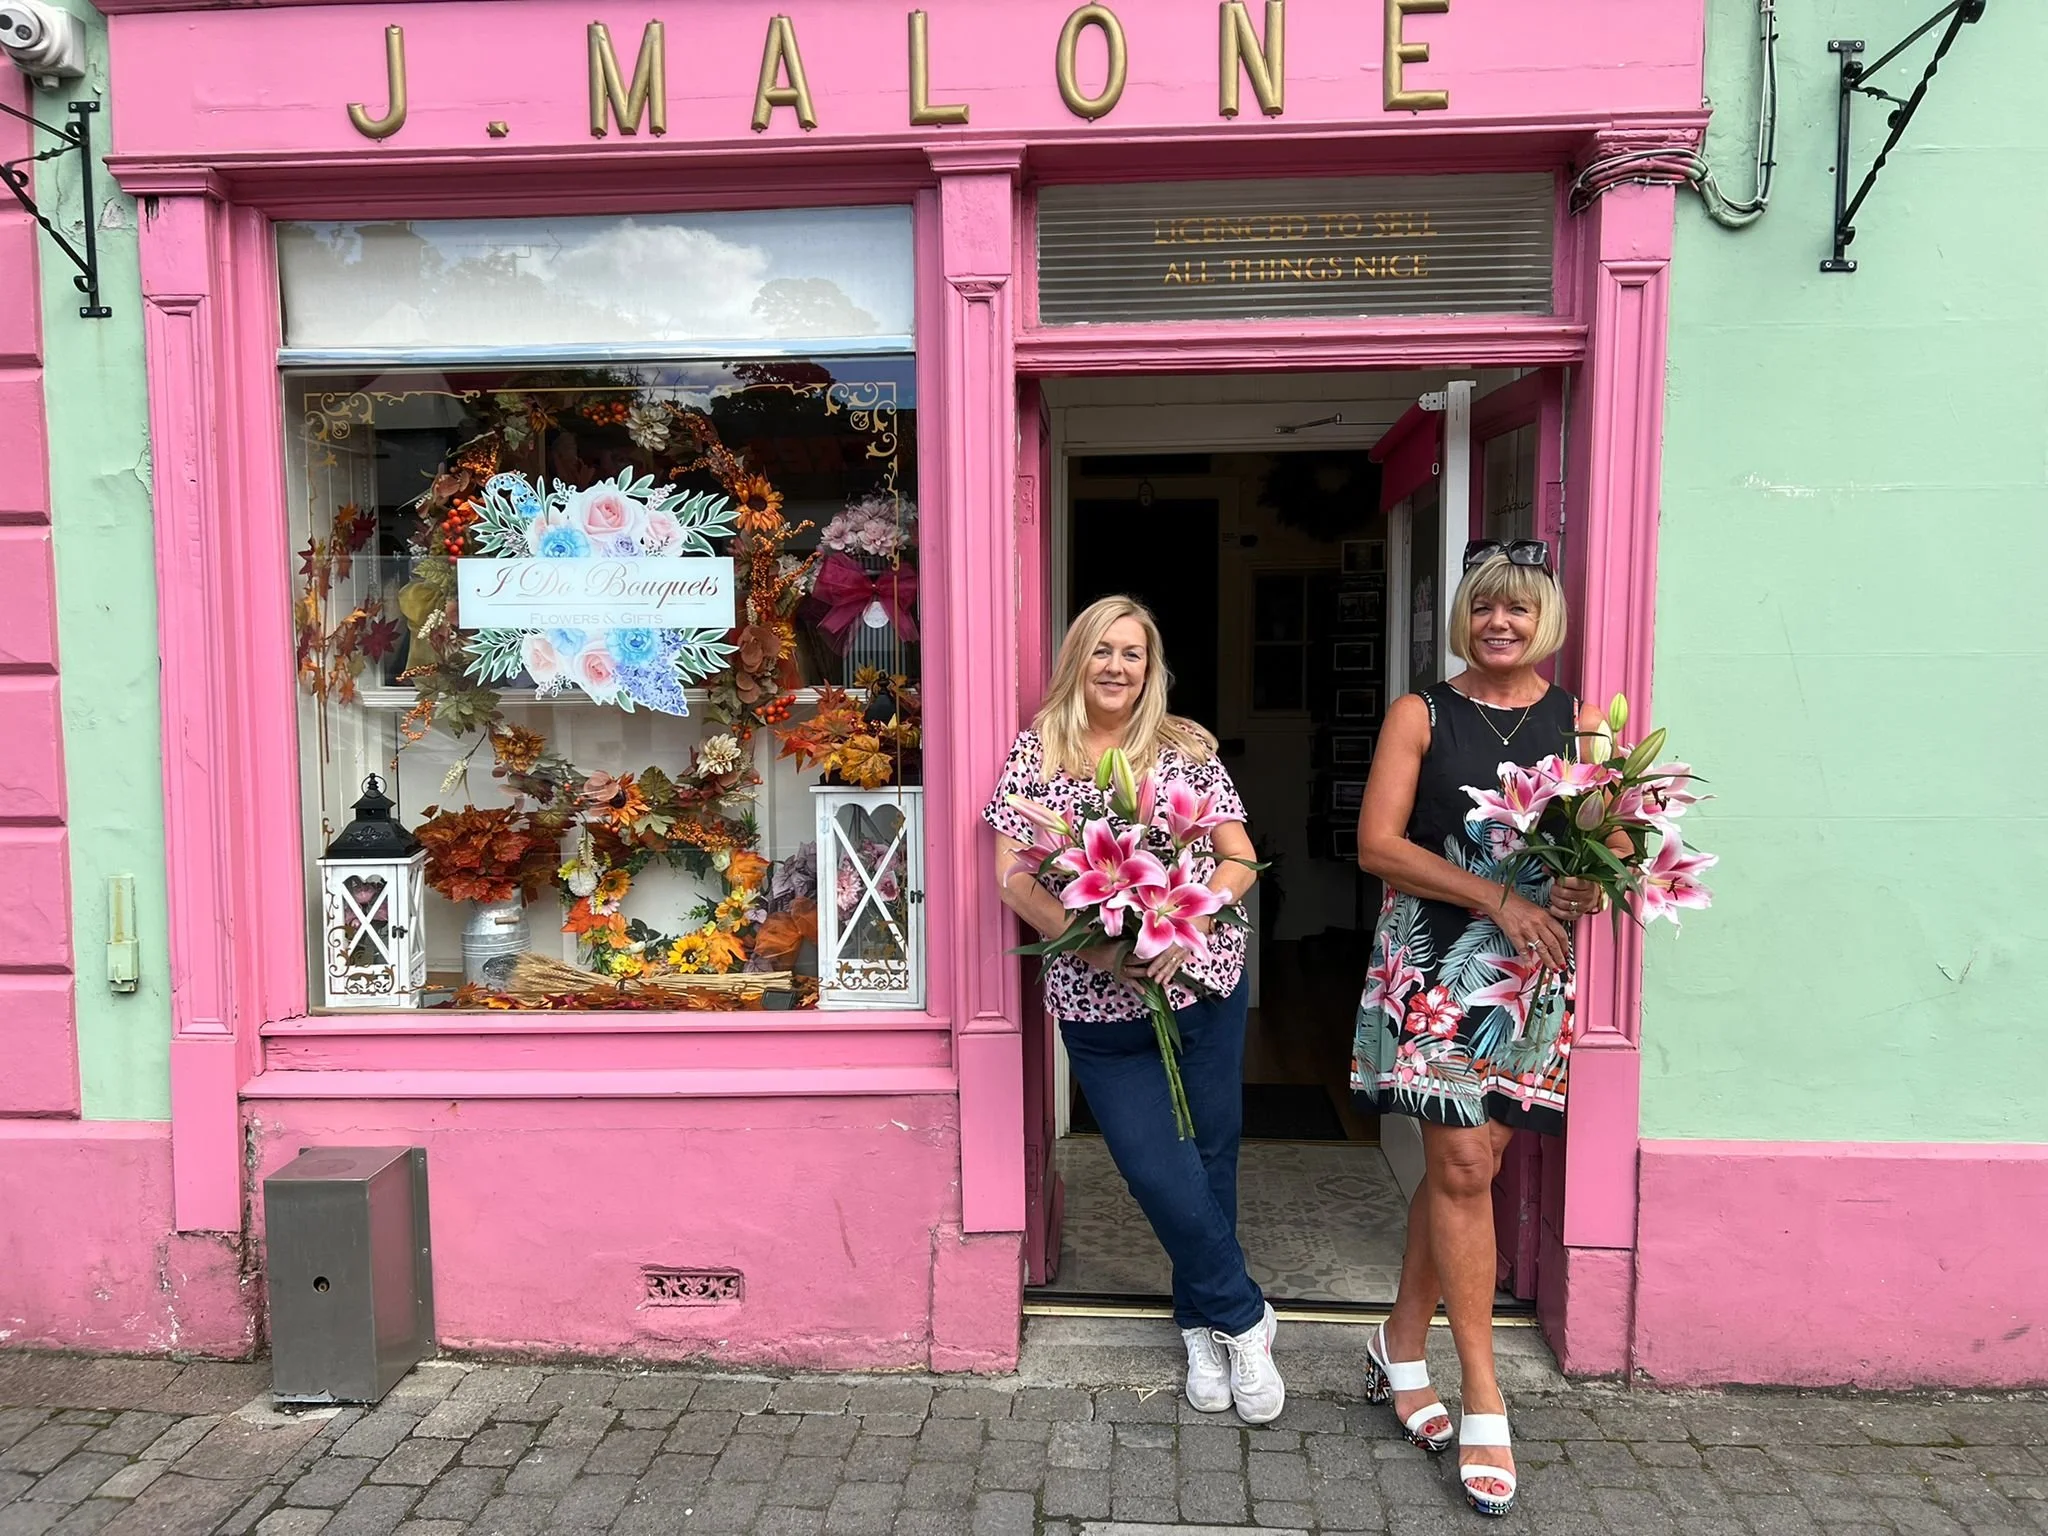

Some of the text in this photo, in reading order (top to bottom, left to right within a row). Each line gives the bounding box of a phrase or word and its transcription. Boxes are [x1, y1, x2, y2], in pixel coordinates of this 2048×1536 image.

[588, 0, 1450, 138] MALONE
[1154, 209, 1438, 244] LICENCED TO SELL
[1163, 253, 1429, 285] ALL THINGS NICE
[516, 561, 574, 599] Do
[584, 561, 719, 609] Bouquets
[603, 612, 617, 625] &
